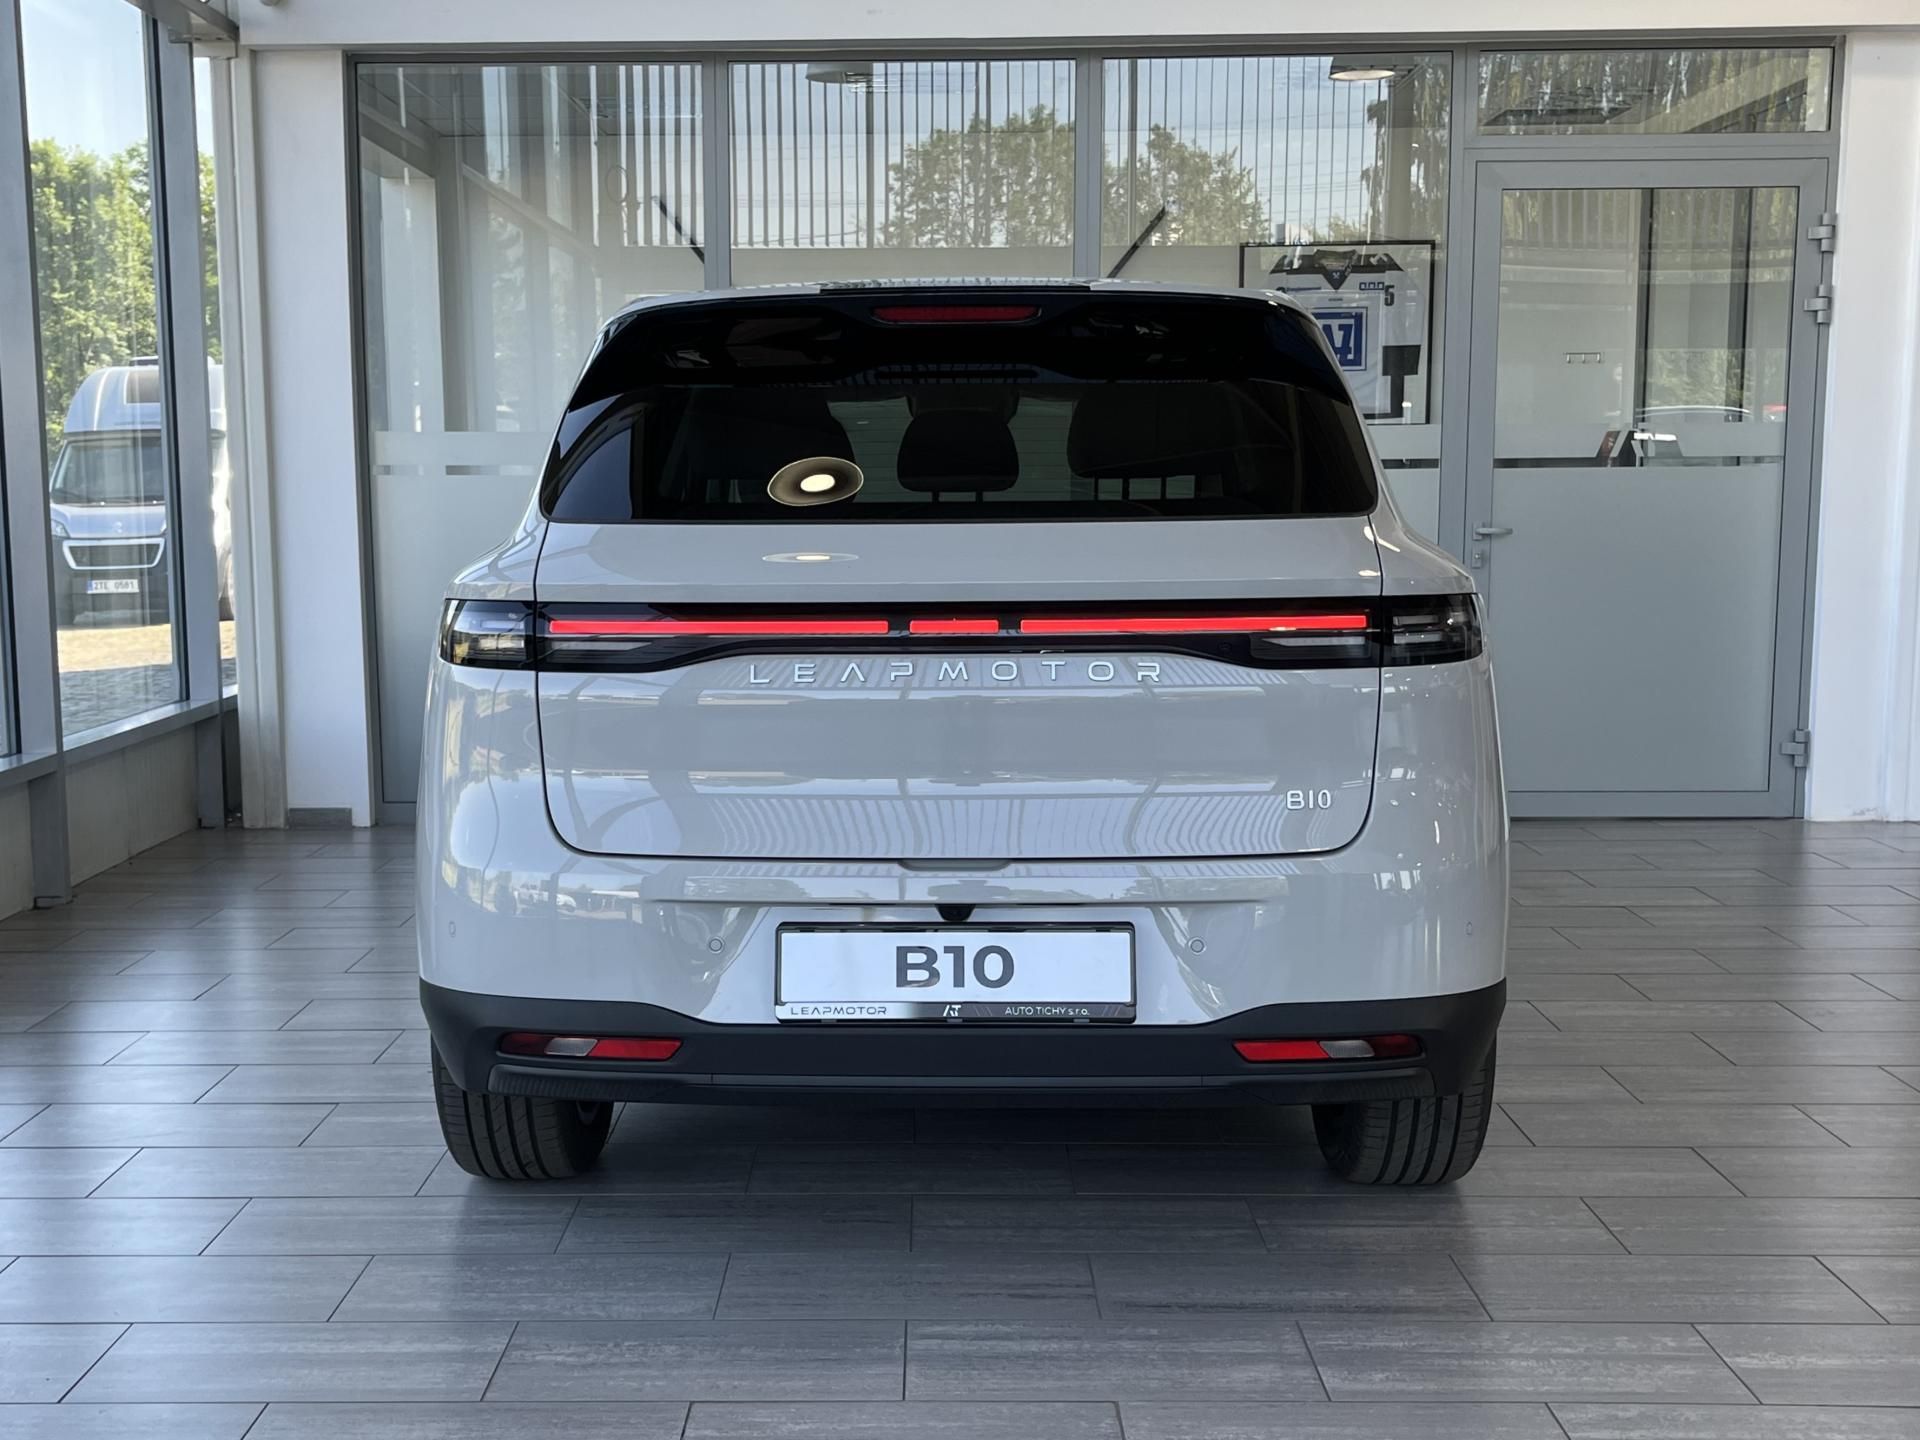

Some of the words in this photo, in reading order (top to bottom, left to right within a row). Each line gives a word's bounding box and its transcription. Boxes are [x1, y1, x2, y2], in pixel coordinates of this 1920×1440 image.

[750, 660, 1161, 684] LEAPMOTOR
[1287, 789, 1331, 809] B10
[896, 945, 1015, 988] B10
[790, 1006, 887, 1015] LEAPMOTOR
[1004, 1006, 1034, 1016] AUTO
[1036, 1006, 1066, 1016] TICHY
